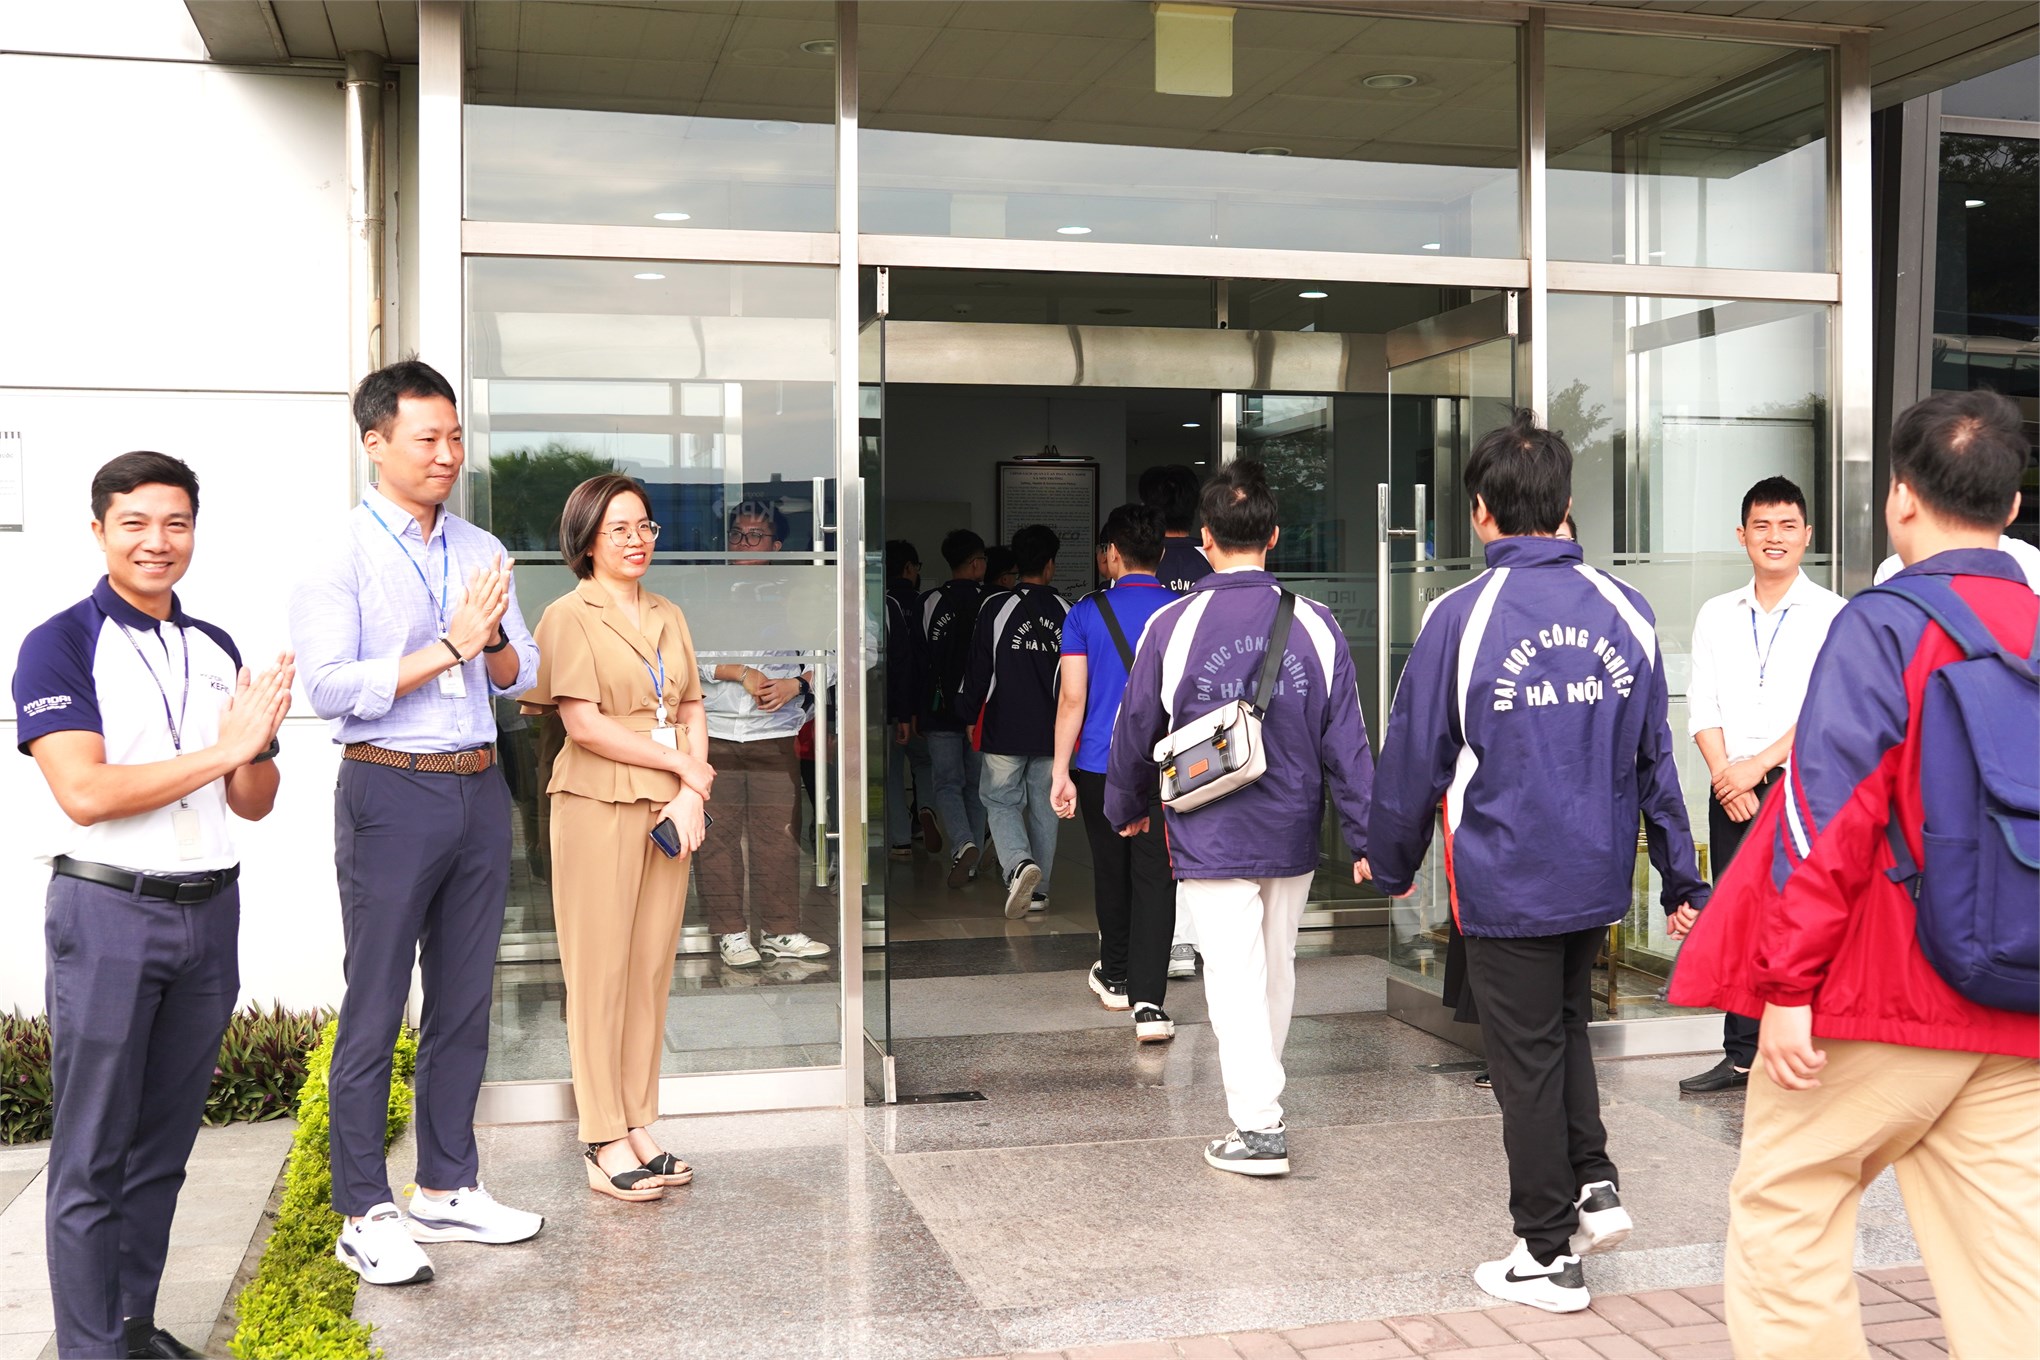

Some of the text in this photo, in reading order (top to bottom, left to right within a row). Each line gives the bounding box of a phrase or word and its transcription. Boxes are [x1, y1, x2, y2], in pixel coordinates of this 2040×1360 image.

[1170, 578, 1196, 591] CÔN
[1039, 616, 1055, 630] ÔNG
[1025, 639, 1039, 651] HÀ
[1204, 645, 1232, 675] HỌC
[1493, 623, 1635, 712] ĐẠI HỌC CÔNG NGHIỆP
[1282, 649, 1310, 697] GHIỆP
[1197, 676, 1213, 701] ĐẠI
[1220, 678, 1246, 699] HÀ
[1525, 675, 1603, 707] HÀ NỘI
